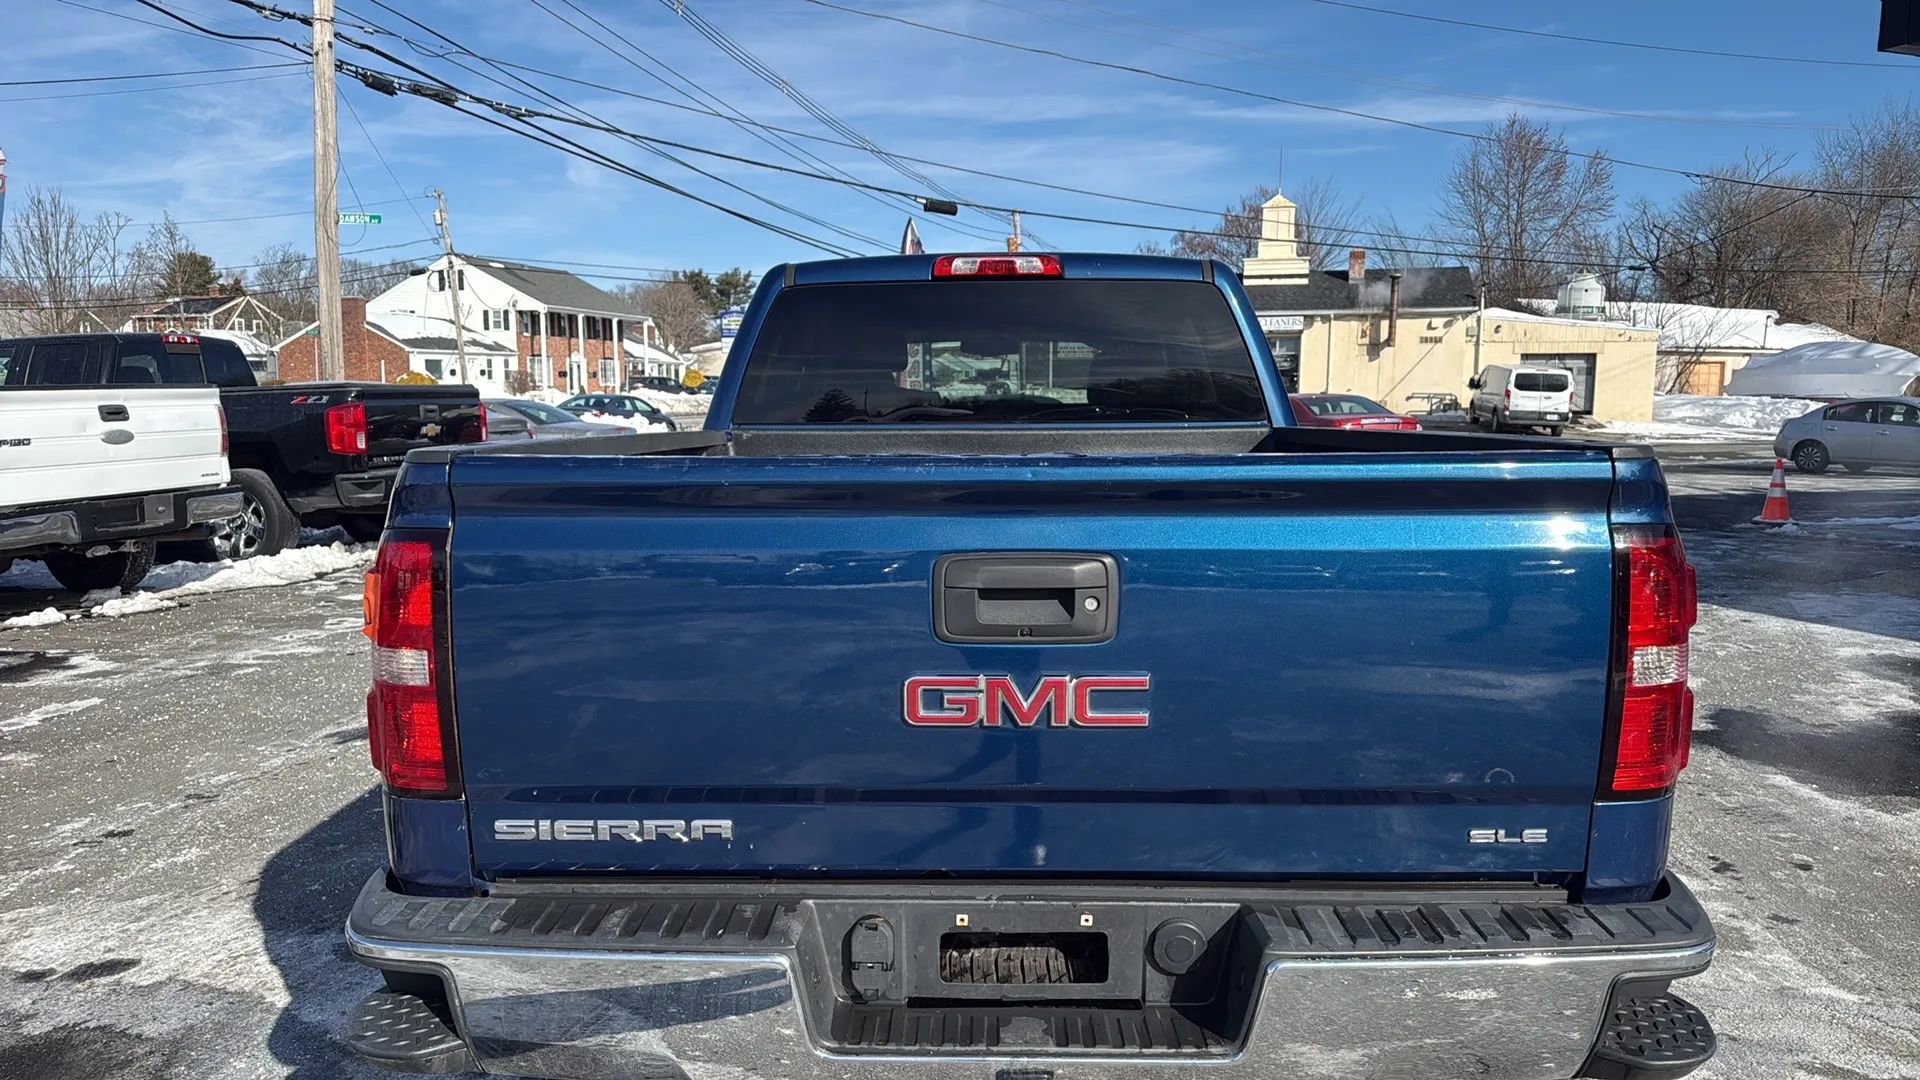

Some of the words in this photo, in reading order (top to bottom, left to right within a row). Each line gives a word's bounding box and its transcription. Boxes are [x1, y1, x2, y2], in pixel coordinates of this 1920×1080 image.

[904, 672, 1151, 728] GMC
[494, 819, 733, 843] SIERRA
[1467, 828, 1548, 844] SLE
